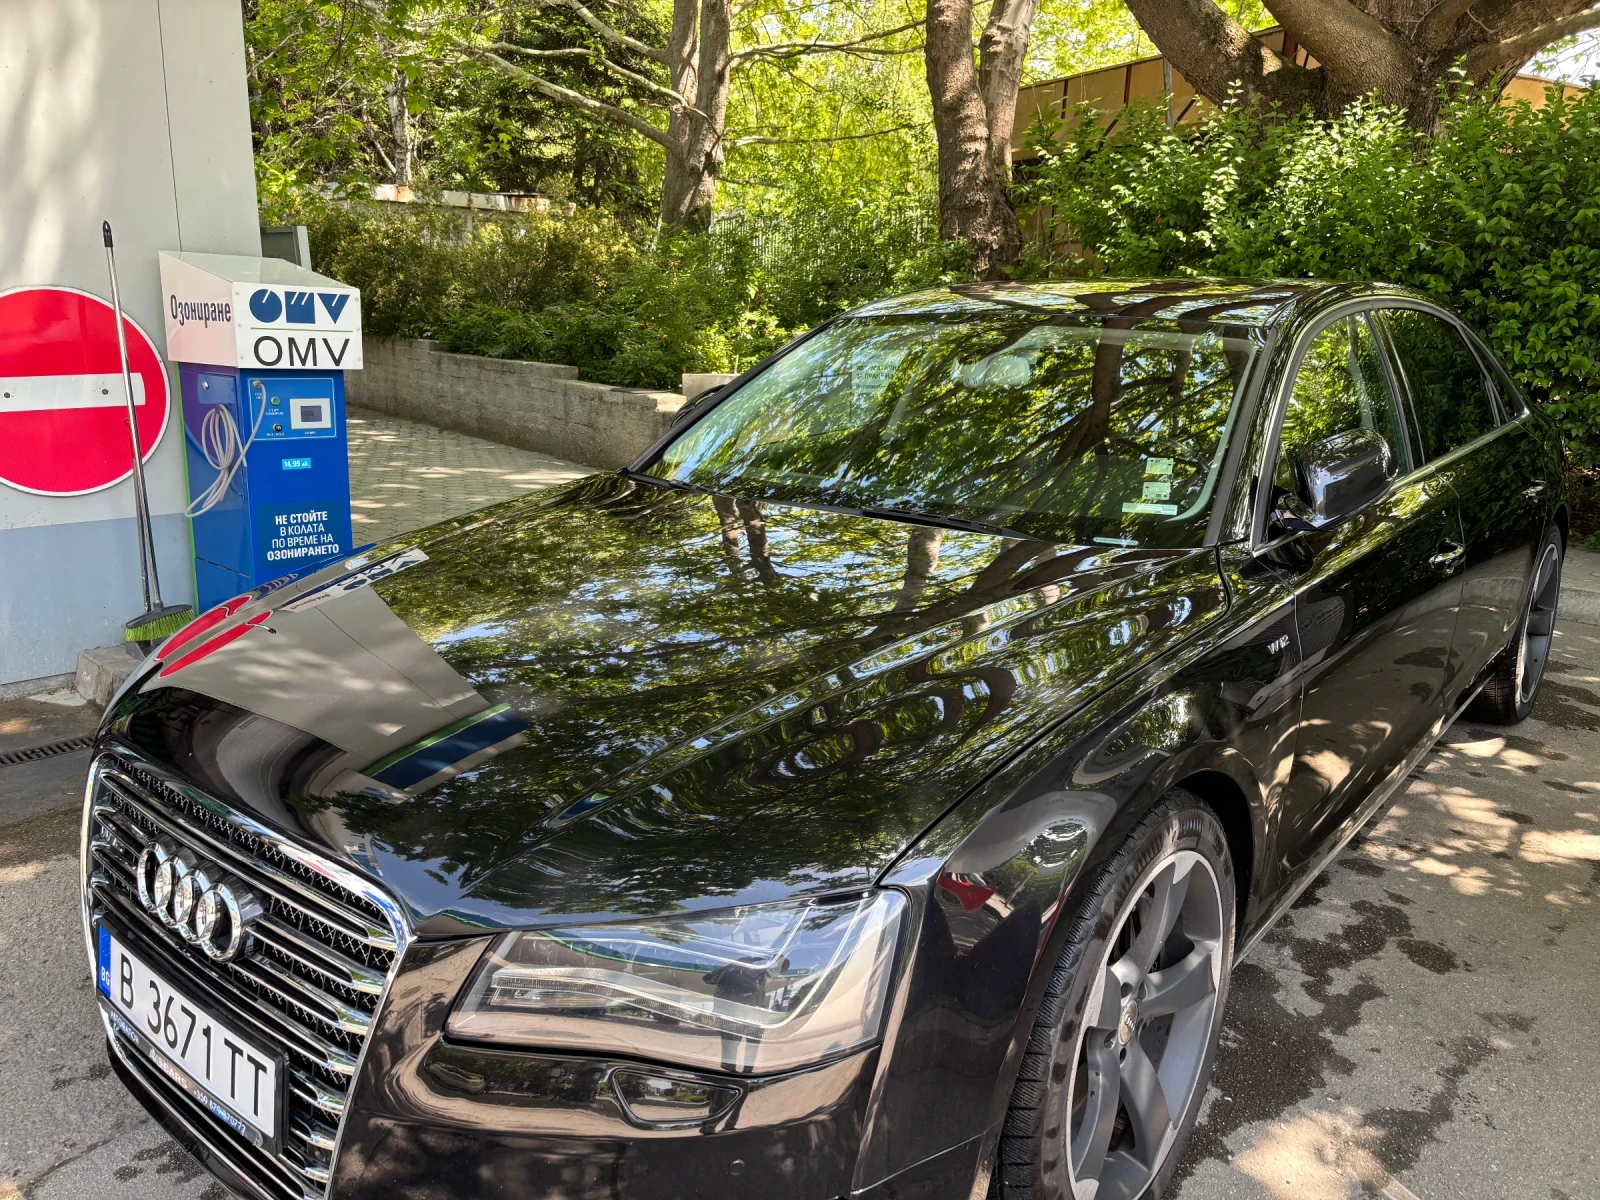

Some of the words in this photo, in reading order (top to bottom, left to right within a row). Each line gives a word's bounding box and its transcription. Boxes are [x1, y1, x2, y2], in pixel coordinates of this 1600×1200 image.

[170, 295, 232, 328] Озониране
[254, 336, 350, 367] OMV
[284, 460, 300, 468] 14,99
[275, 515, 288, 525] НЕ
[290, 510, 328, 523] СТОЙТЕ
[280, 526, 286, 536] В
[288, 522, 325, 536] КОЛАТА
[272, 538, 285, 549] ПО
[287, 534, 319, 547] ВРЕМЕ
[320, 533, 334, 544] НА
[267, 544, 340, 561] ОЗОНИРАНЕТО
[101, 966, 110, 987] BG
[121, 952, 135, 1011] B
[147, 980, 213, 1083] 3671
[224, 1037, 268, 1119] TT
